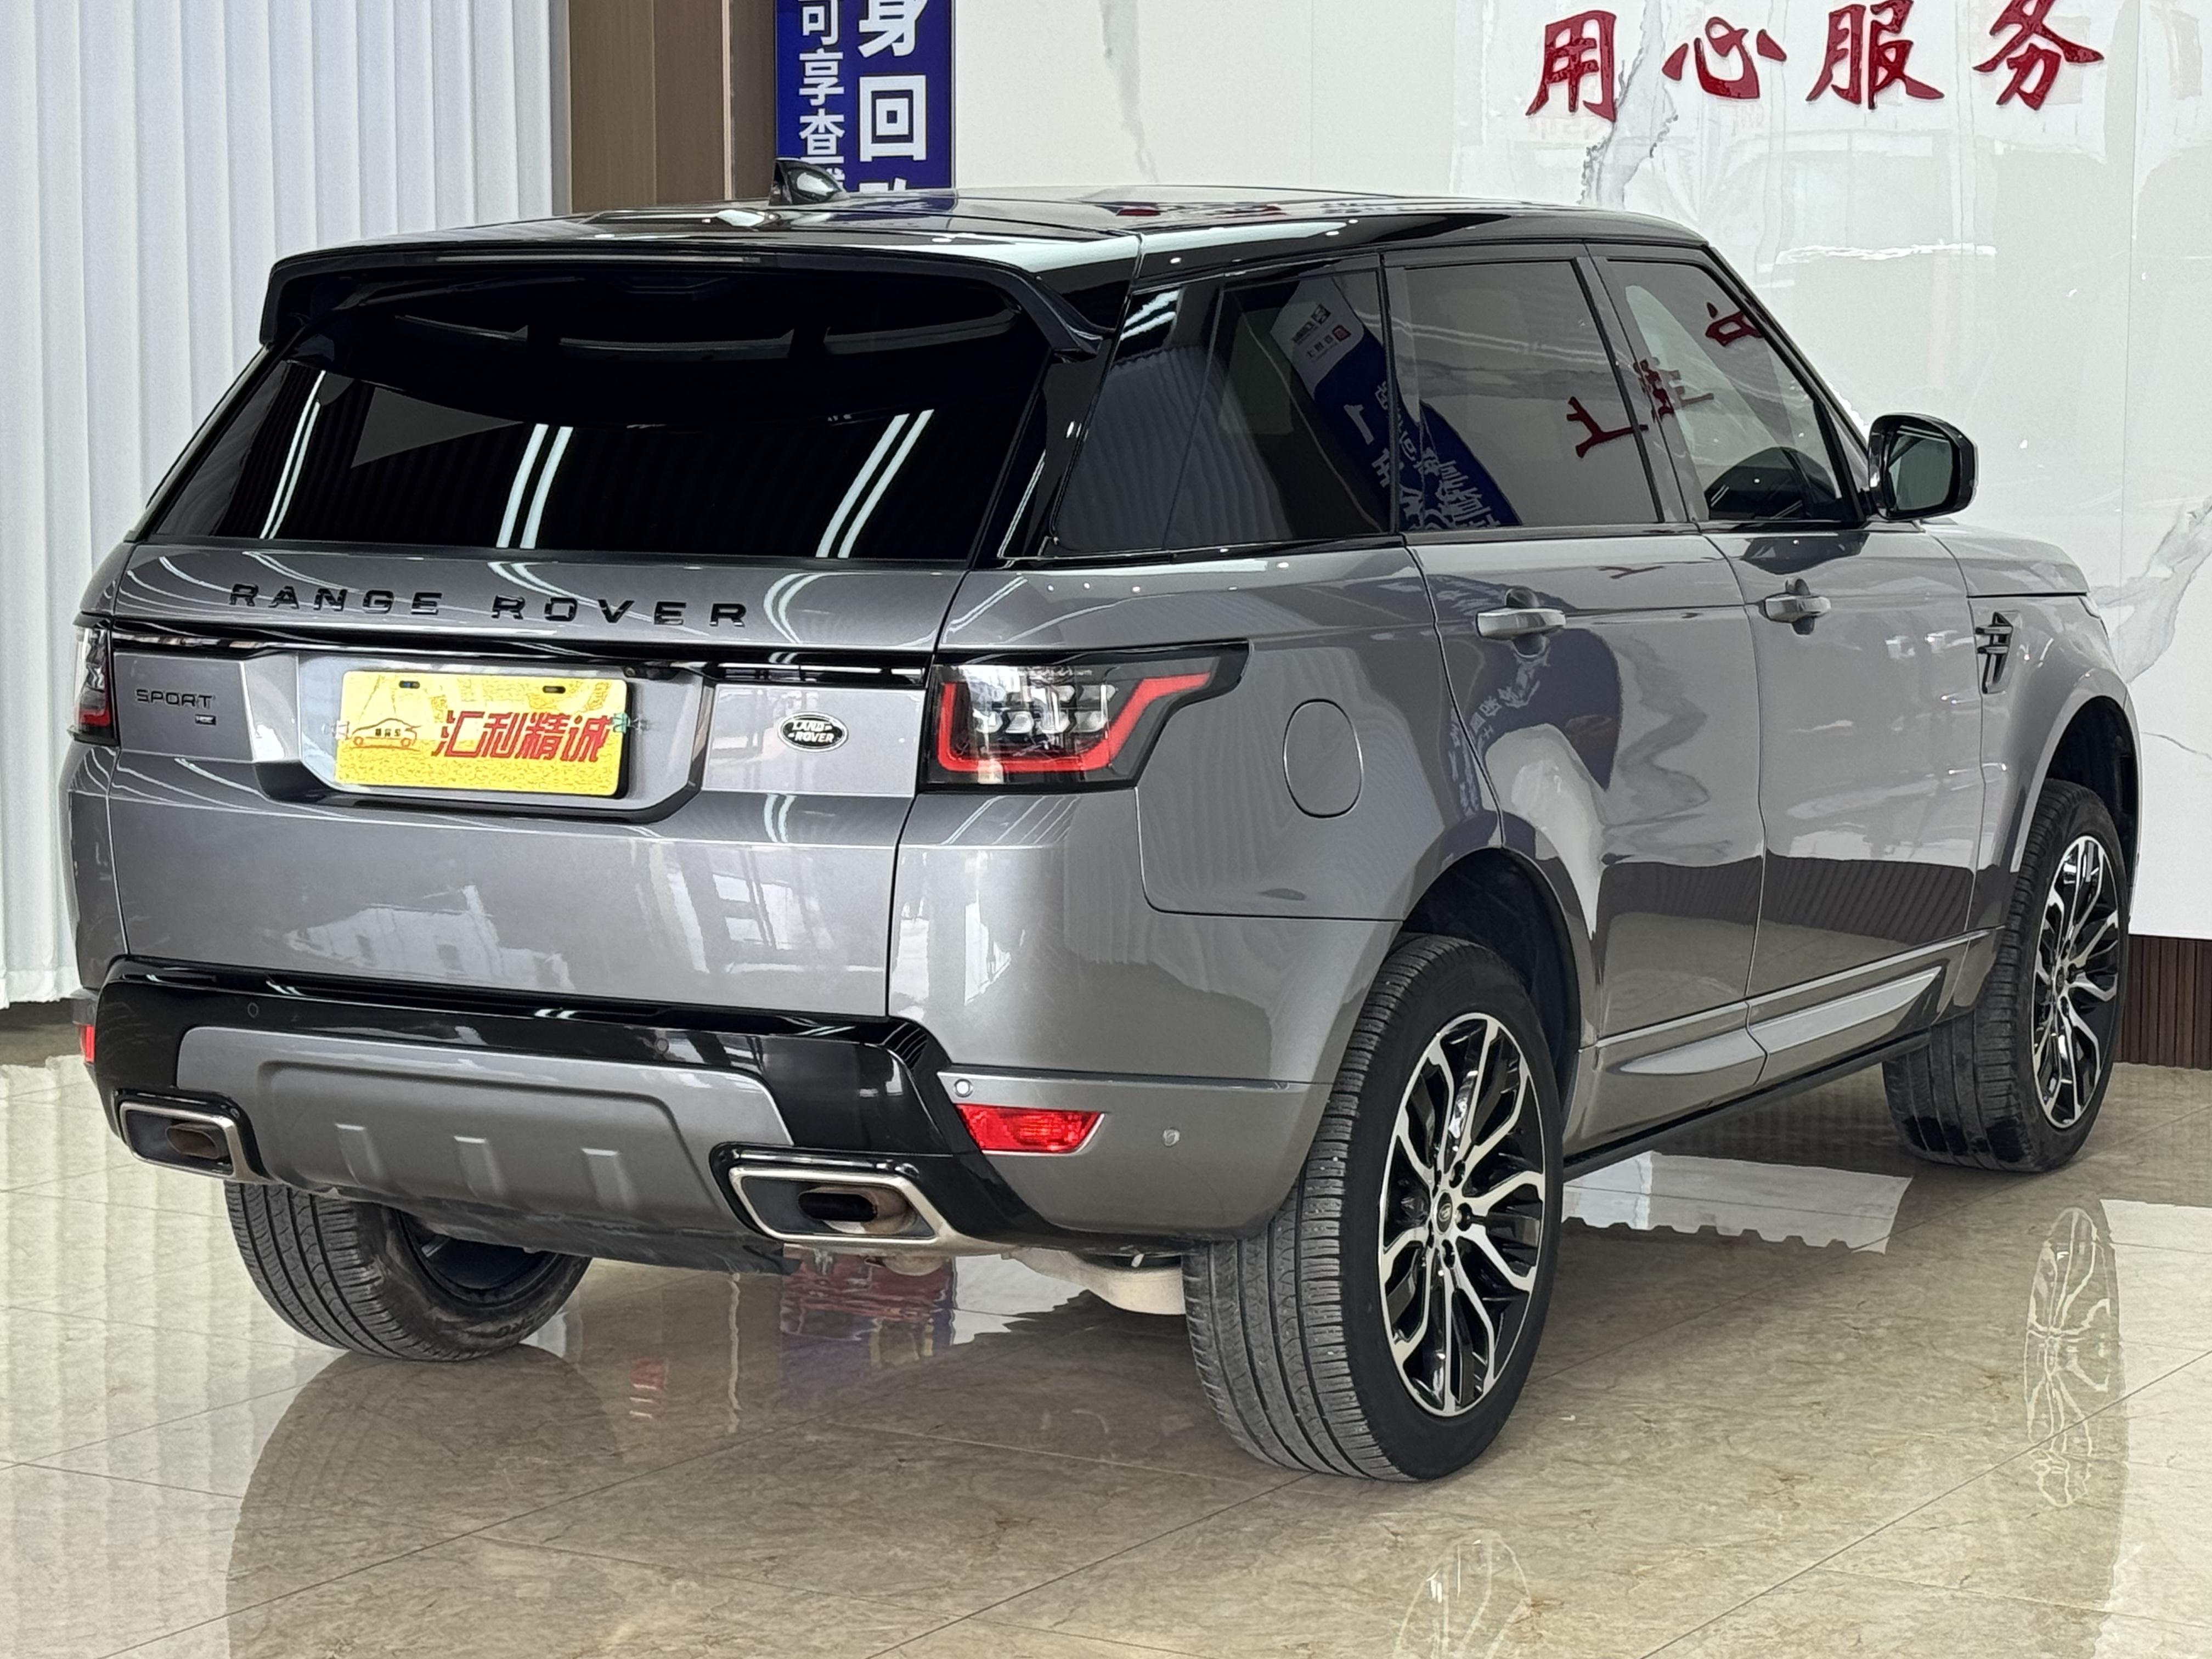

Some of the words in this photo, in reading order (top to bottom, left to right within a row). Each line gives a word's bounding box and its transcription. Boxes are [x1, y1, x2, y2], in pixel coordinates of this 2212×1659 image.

[799, 0, 845, 191] 可享查
[858, 0, 929, 191] 身回
[1525, 0, 2105, 122] 用心服务
[228, 584, 442, 615] RANGE
[491, 595, 747, 627] ROVER
[136, 689, 212, 708] SPORT
[431, 710, 613, 762] 汇利精诚
